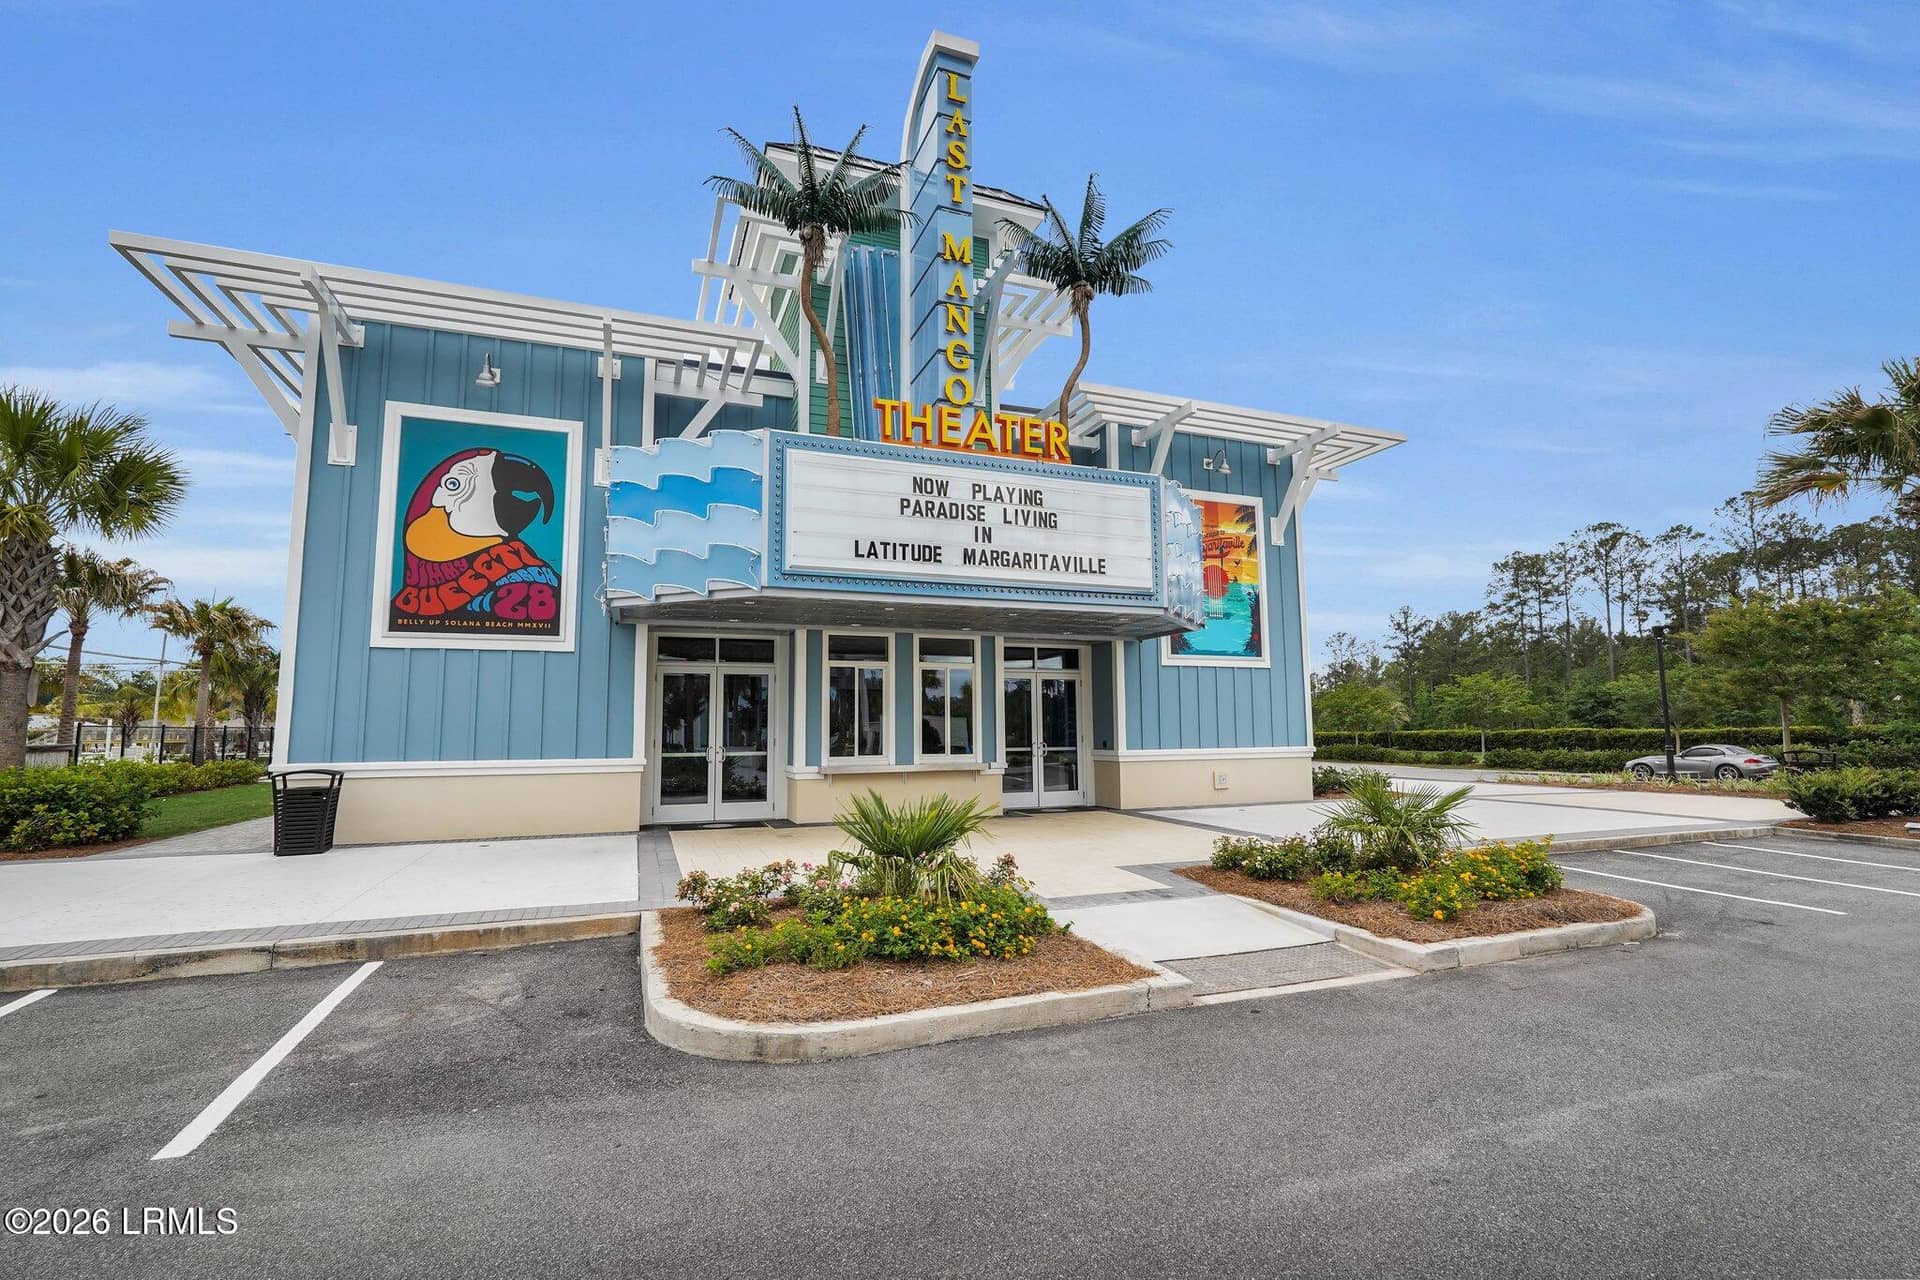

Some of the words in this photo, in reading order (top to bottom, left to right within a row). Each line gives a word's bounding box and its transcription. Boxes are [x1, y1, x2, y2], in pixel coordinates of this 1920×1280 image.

[945, 73, 968, 205] LAST
[942, 232, 974, 406] MANGO
[873, 398, 1071, 460] THEATER
[912, 476, 950, 497] NOW
[971, 483, 1043, 507] PLAYING
[900, 498, 986, 522] PARADISE
[1003, 507, 1058, 529] LIVING
[974, 525, 992, 544] IN
[854, 539, 942, 564] LATITUDE
[963, 548, 1106, 575] MARGARITAVILLE
[495, 566, 558, 587] MARCH
[494, 582, 556, 620] 28
